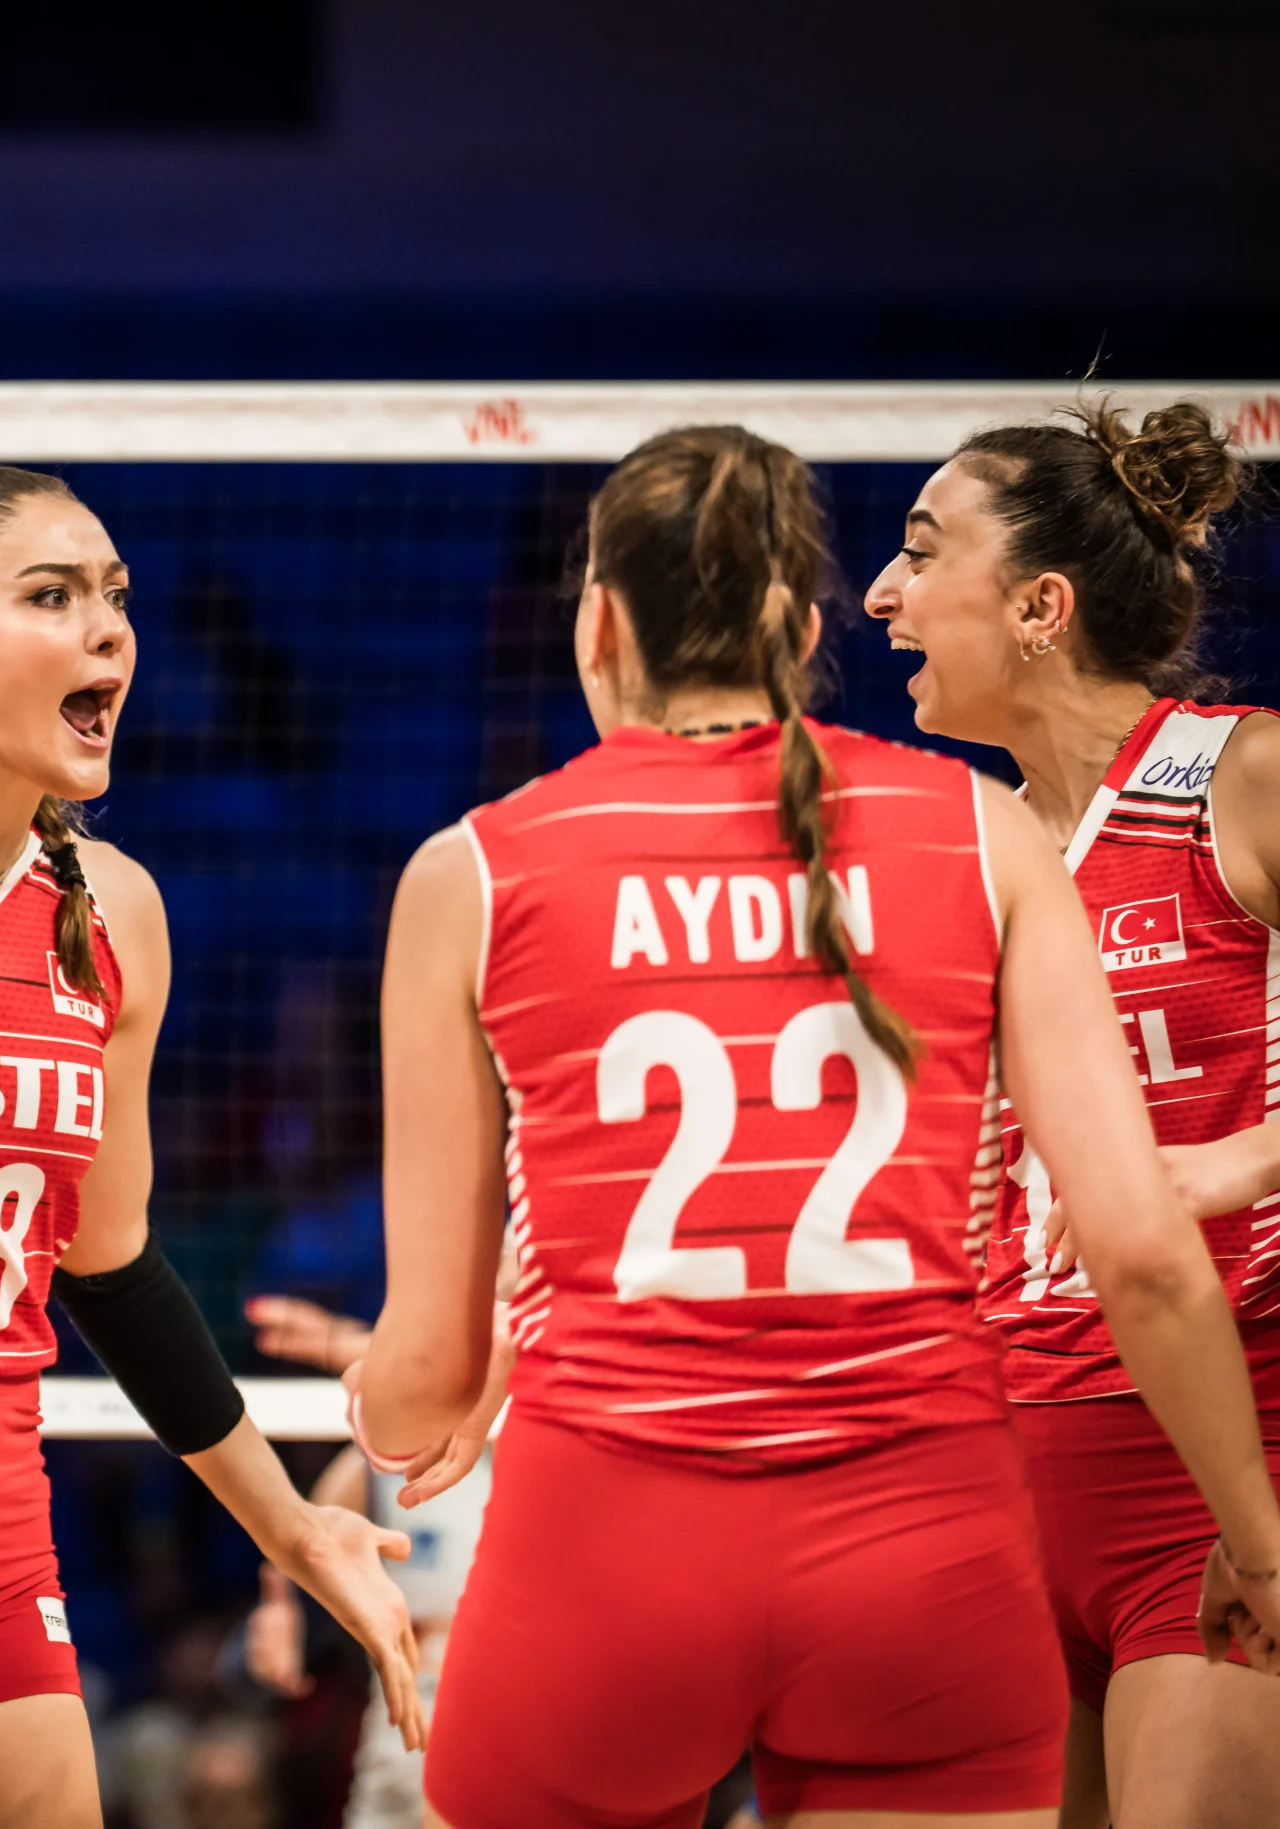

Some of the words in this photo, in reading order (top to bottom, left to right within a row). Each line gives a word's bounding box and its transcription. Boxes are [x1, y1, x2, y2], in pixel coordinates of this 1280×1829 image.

[1225, 394, 1280, 446] VN
[1115, 946, 1162, 966] TUR
[67, 999, 94, 1019] TUR
[597, 1002, 915, 1303] 22
